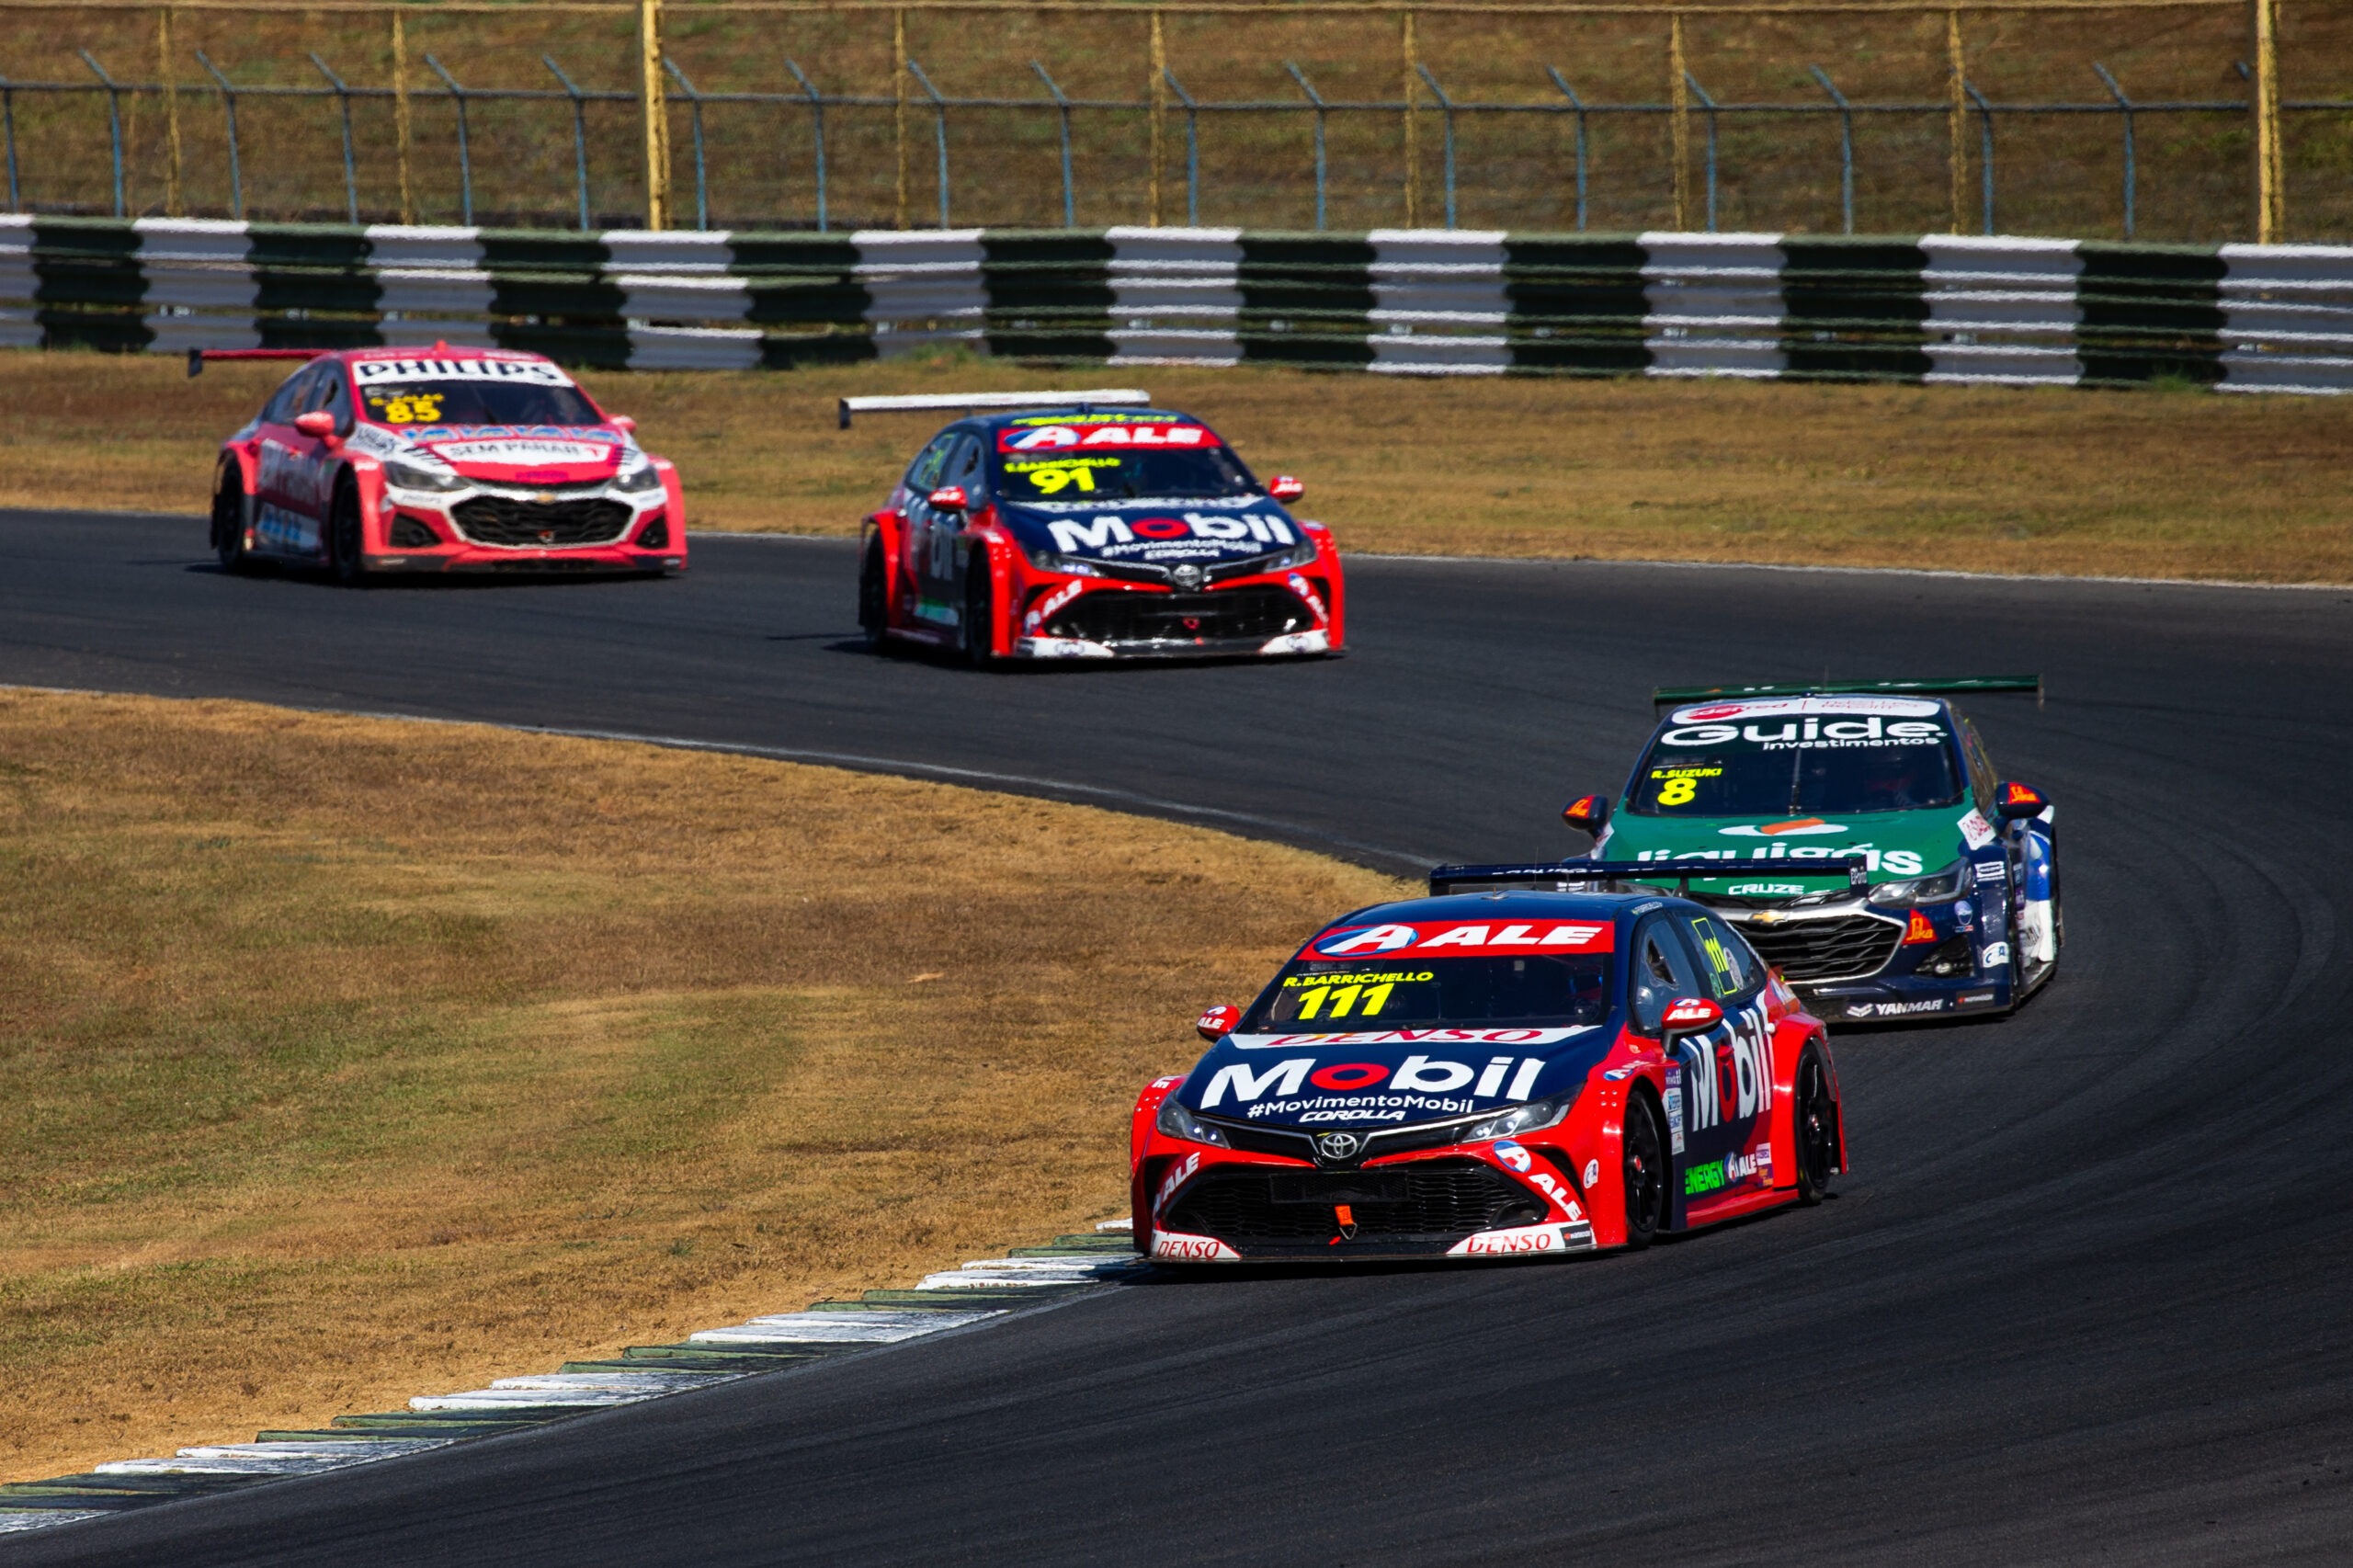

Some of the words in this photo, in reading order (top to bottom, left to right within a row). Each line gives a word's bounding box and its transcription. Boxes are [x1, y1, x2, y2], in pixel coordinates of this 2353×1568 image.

[359, 360, 558, 379] PHILIPS
[386, 399, 442, 424] 85
[1082, 426, 1203, 444] ALE
[1029, 466, 1096, 494] 91
[1047, 512, 1296, 553] Mobil
[1042, 579, 1083, 617] ALE
[1763, 736, 1941, 751] investimentos
[1651, 767, 1723, 779] R.SUZUKI
[1657, 777, 1698, 806] 8
[1728, 882, 1805, 896] CRUZE
[1417, 925, 1604, 948] ALE
[1283, 971, 1435, 988] R.BARRICHELLO
[1298, 983, 1395, 1020] 111
[1875, 999, 1944, 1016] YANMAR
[1197, 1017, 1226, 1029] ALE
[1666, 1008, 1711, 1021] ALE
[1266, 1028, 1544, 1047] DENSO
[1680, 1007, 1772, 1133] Mobil
[1200, 1055, 1546, 1110] Mobil
[1247, 1095, 1474, 1119] #MovimentoMobil
[1299, 1108, 1405, 1123] COROLLA
[1739, 1153, 1757, 1177] ALE
[1162, 1152, 1201, 1203] ALE
[1685, 1159, 1725, 1195] ENERGY
[1528, 1173, 1583, 1221] ALE
[1157, 1241, 1221, 1259] DENSO
[1466, 1233, 1552, 1255] DENSO
